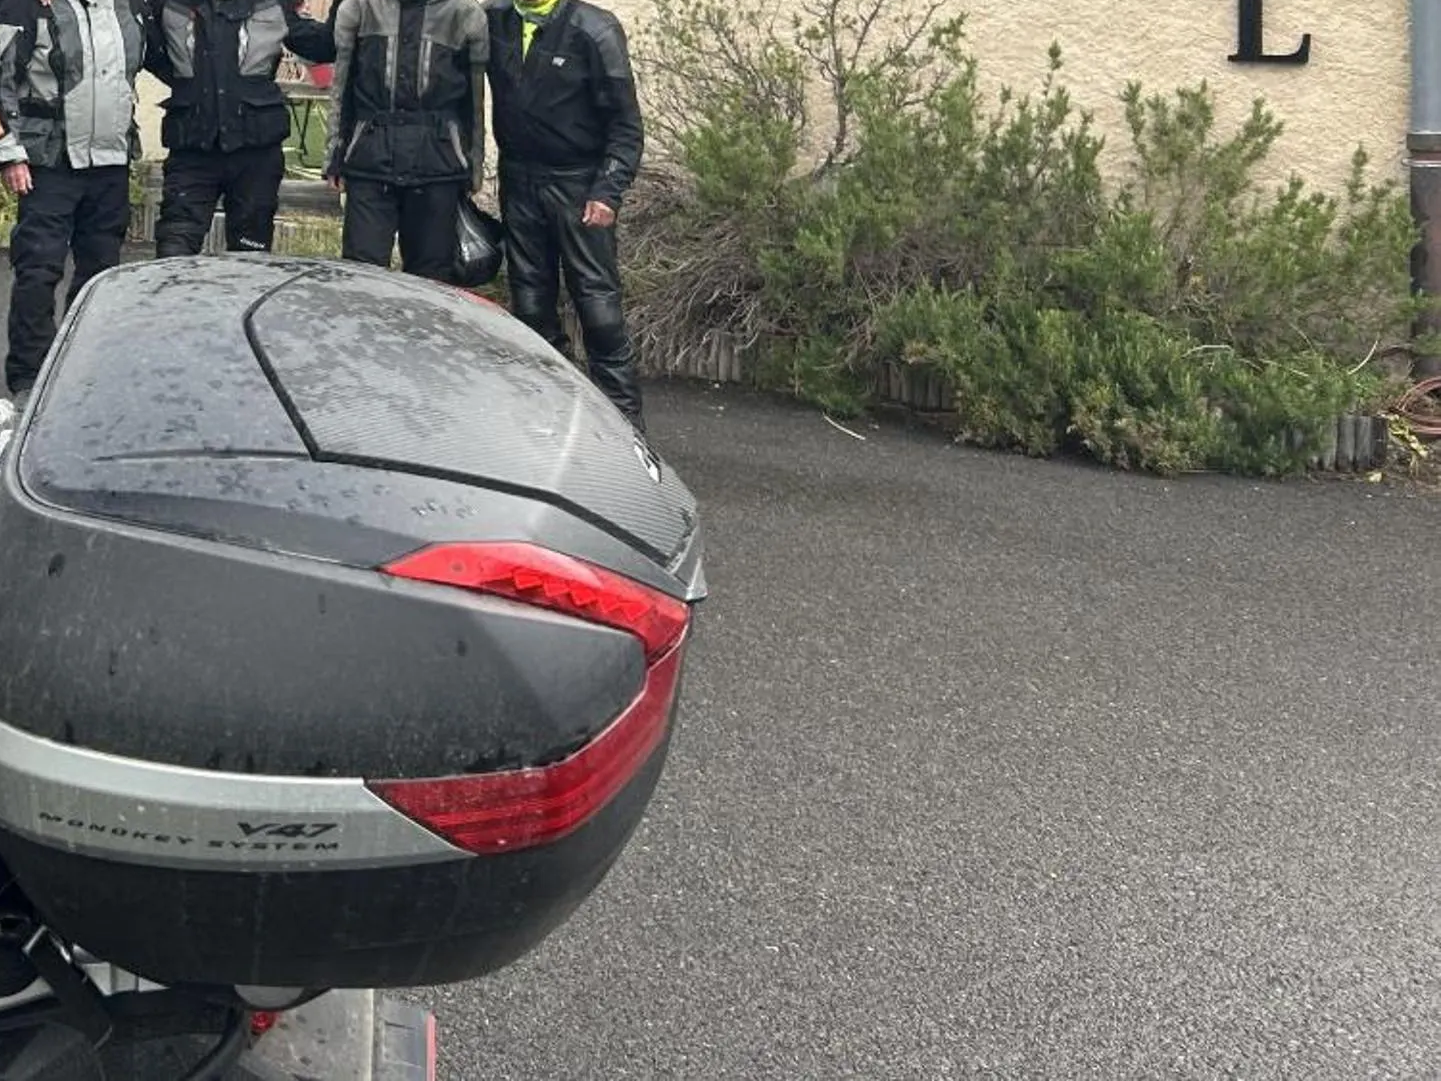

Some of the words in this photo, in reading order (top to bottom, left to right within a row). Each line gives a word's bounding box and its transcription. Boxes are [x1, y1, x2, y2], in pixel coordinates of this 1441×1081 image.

[39, 812, 193, 844] MONOKEY
[208, 840, 339, 850] SYSTEM
[237, 821, 337, 838] V47
